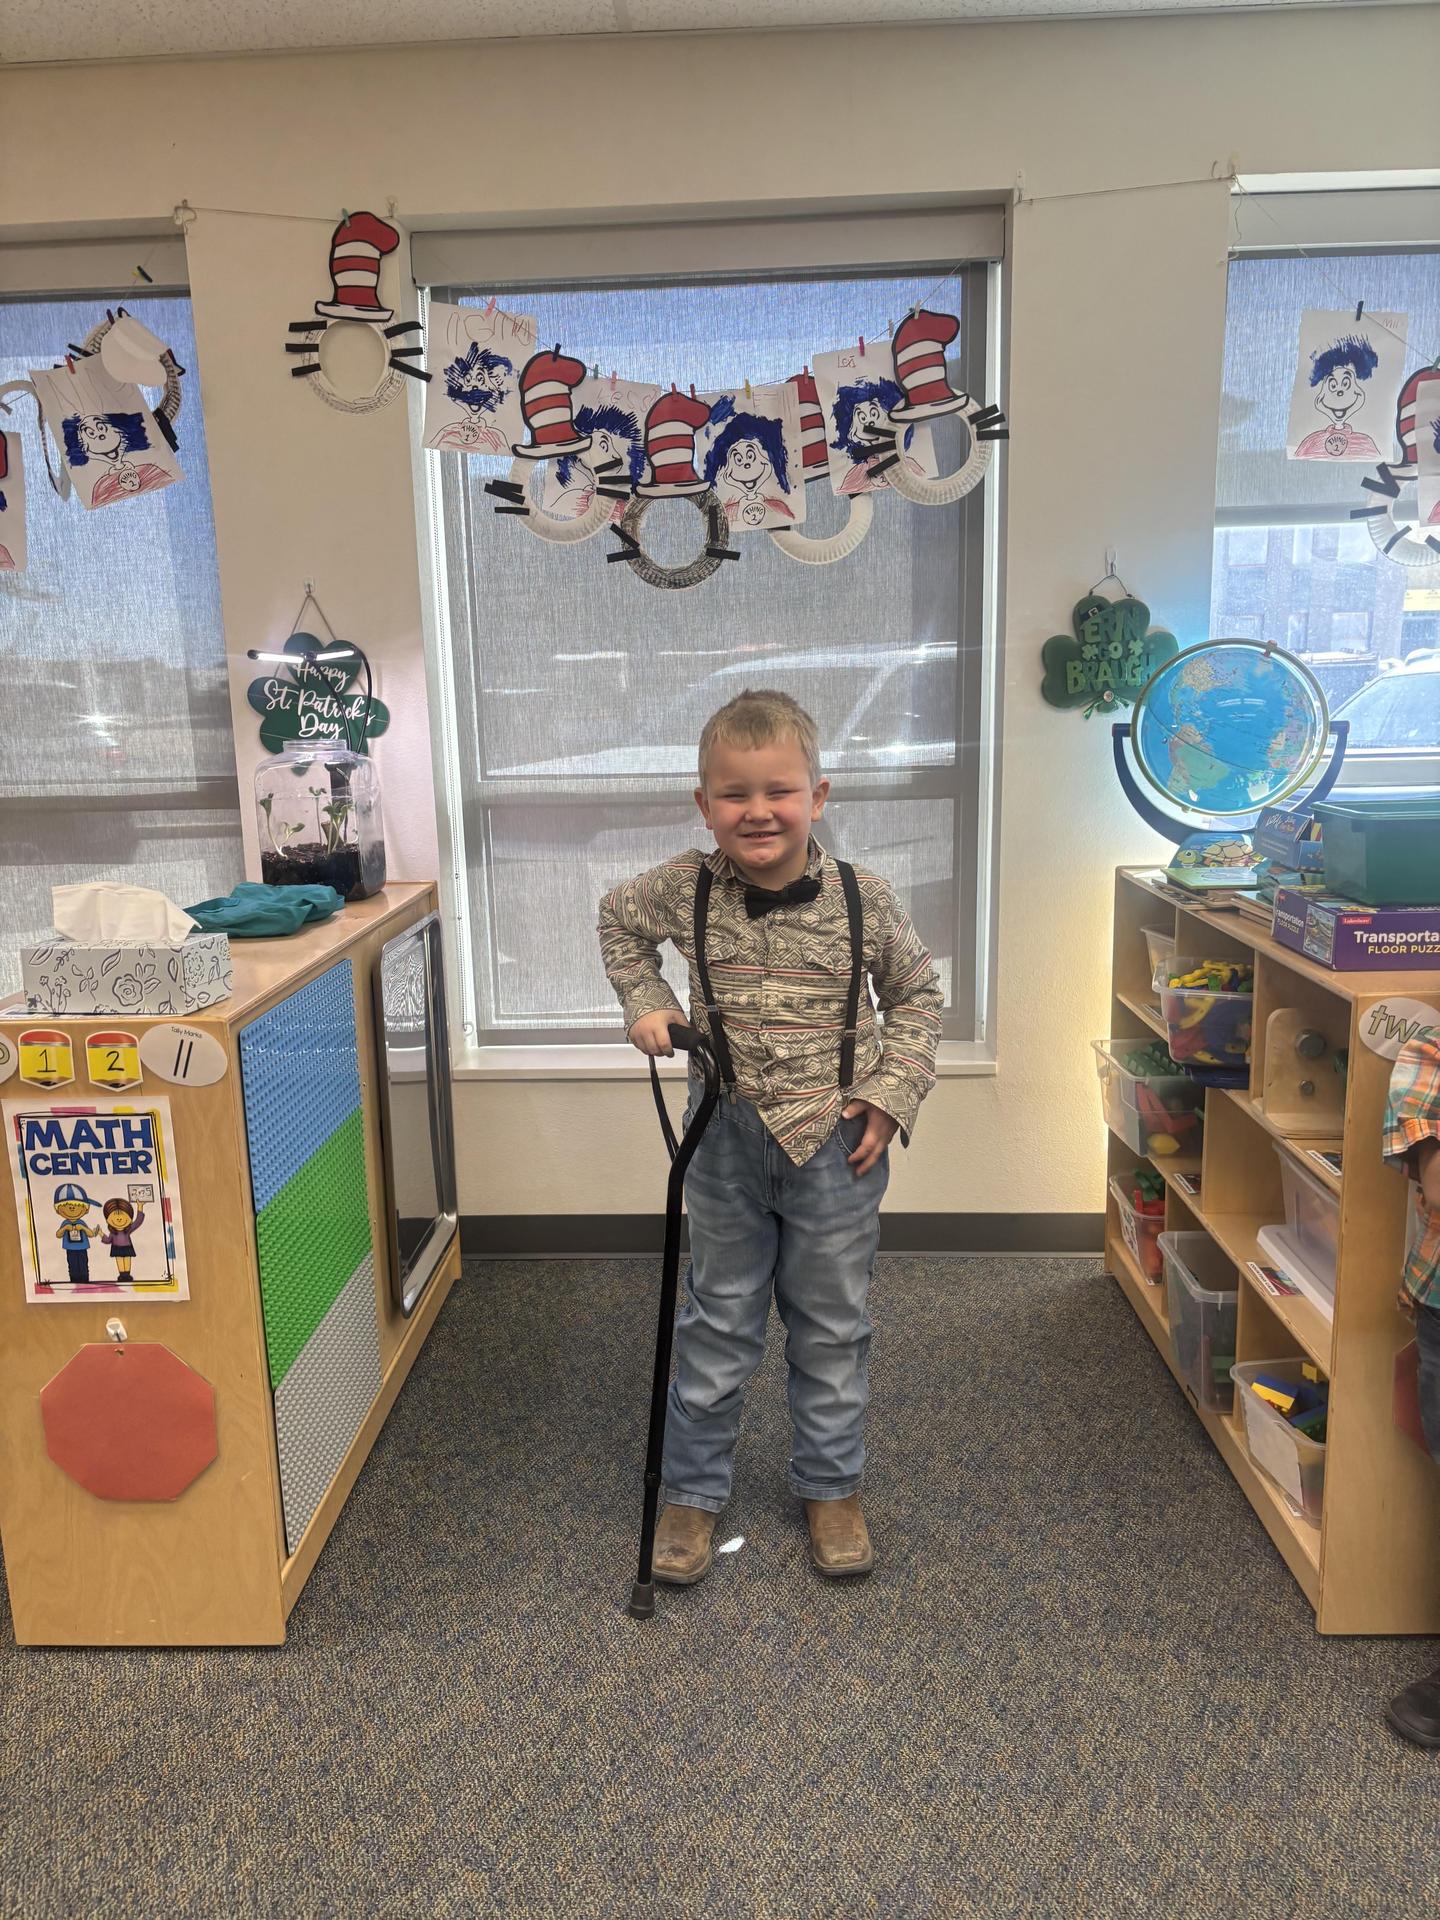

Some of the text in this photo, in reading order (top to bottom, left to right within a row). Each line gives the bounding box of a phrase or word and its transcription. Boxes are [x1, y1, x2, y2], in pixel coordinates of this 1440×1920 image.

[461, 425, 478, 438] THING
[1327, 436, 1347, 446] THING
[1333, 444, 1340, 452] 2
[120, 472, 137, 484] THING
[745, 505, 764, 516] THING
[751, 513, 758, 522] 2
[1080, 605, 1140, 643] ERIN
[1099, 641, 1123, 660] GO
[292, 661, 350, 692] Happy
[263, 678, 376, 726] St. Patrck's
[298, 712, 344, 740] Day
[1353, 930, 1440, 945] Transporta
[1368, 944, 1440, 954] FLOOR PUZZ
[171, 1026, 202, 1039] Tally Marks
[1368, 1005, 1434, 1044] tw
[37, 1048, 57, 1073] 1
[106, 1050, 125, 1072] 2
[25, 1119, 154, 1151] MATH
[29, 1150, 153, 1176] CENTER
